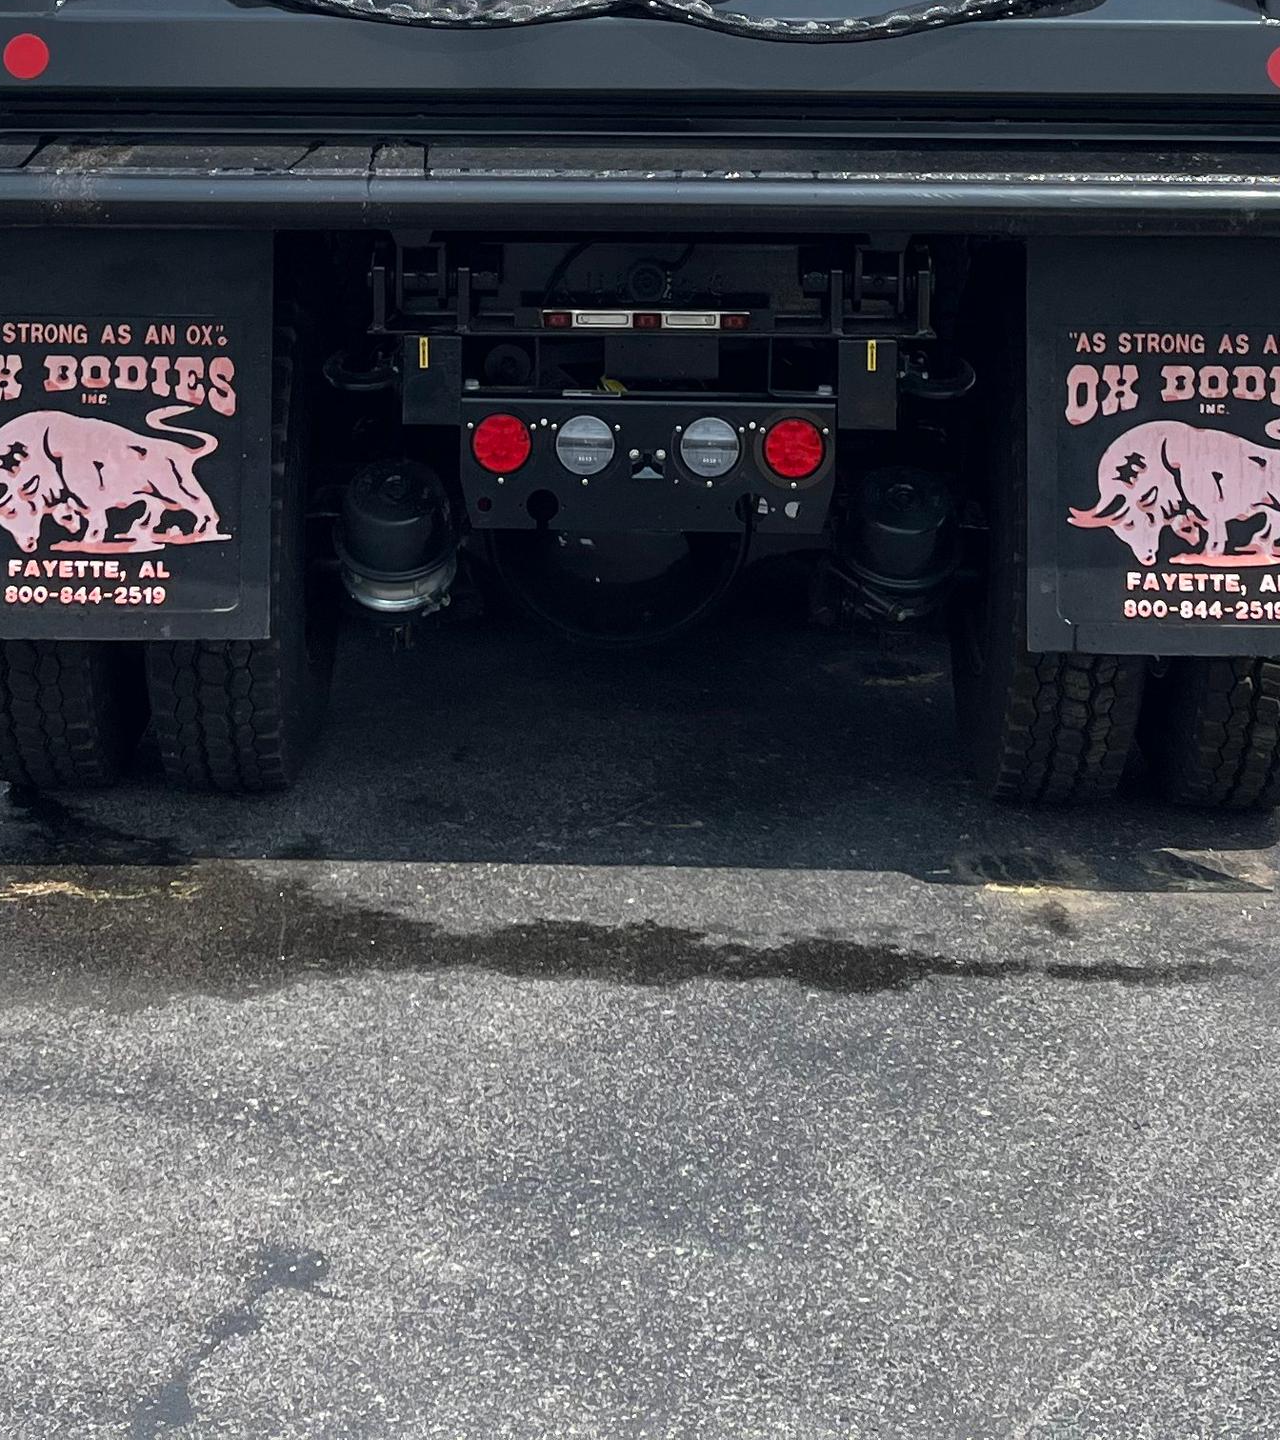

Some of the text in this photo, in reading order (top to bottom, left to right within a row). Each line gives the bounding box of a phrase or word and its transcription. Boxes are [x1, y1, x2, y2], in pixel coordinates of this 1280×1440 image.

[2, 323, 88, 345] STRONG
[101, 324, 132, 345] AS
[145, 325, 176, 345] AN
[1069, 332, 1106, 354] "AS
[1118, 333, 1205, 354] STRONG
[1218, 334, 1250, 354] AS
[43, 354, 237, 416] BODIES
[1065, 363, 1139, 426] OX
[1199, 403, 1230, 415] INC.
[7, 559, 170, 581] FAYETTE, AL
[1126, 572, 1247, 595] FAYETTE,
[4, 586, 166, 605] 800-844-2519
